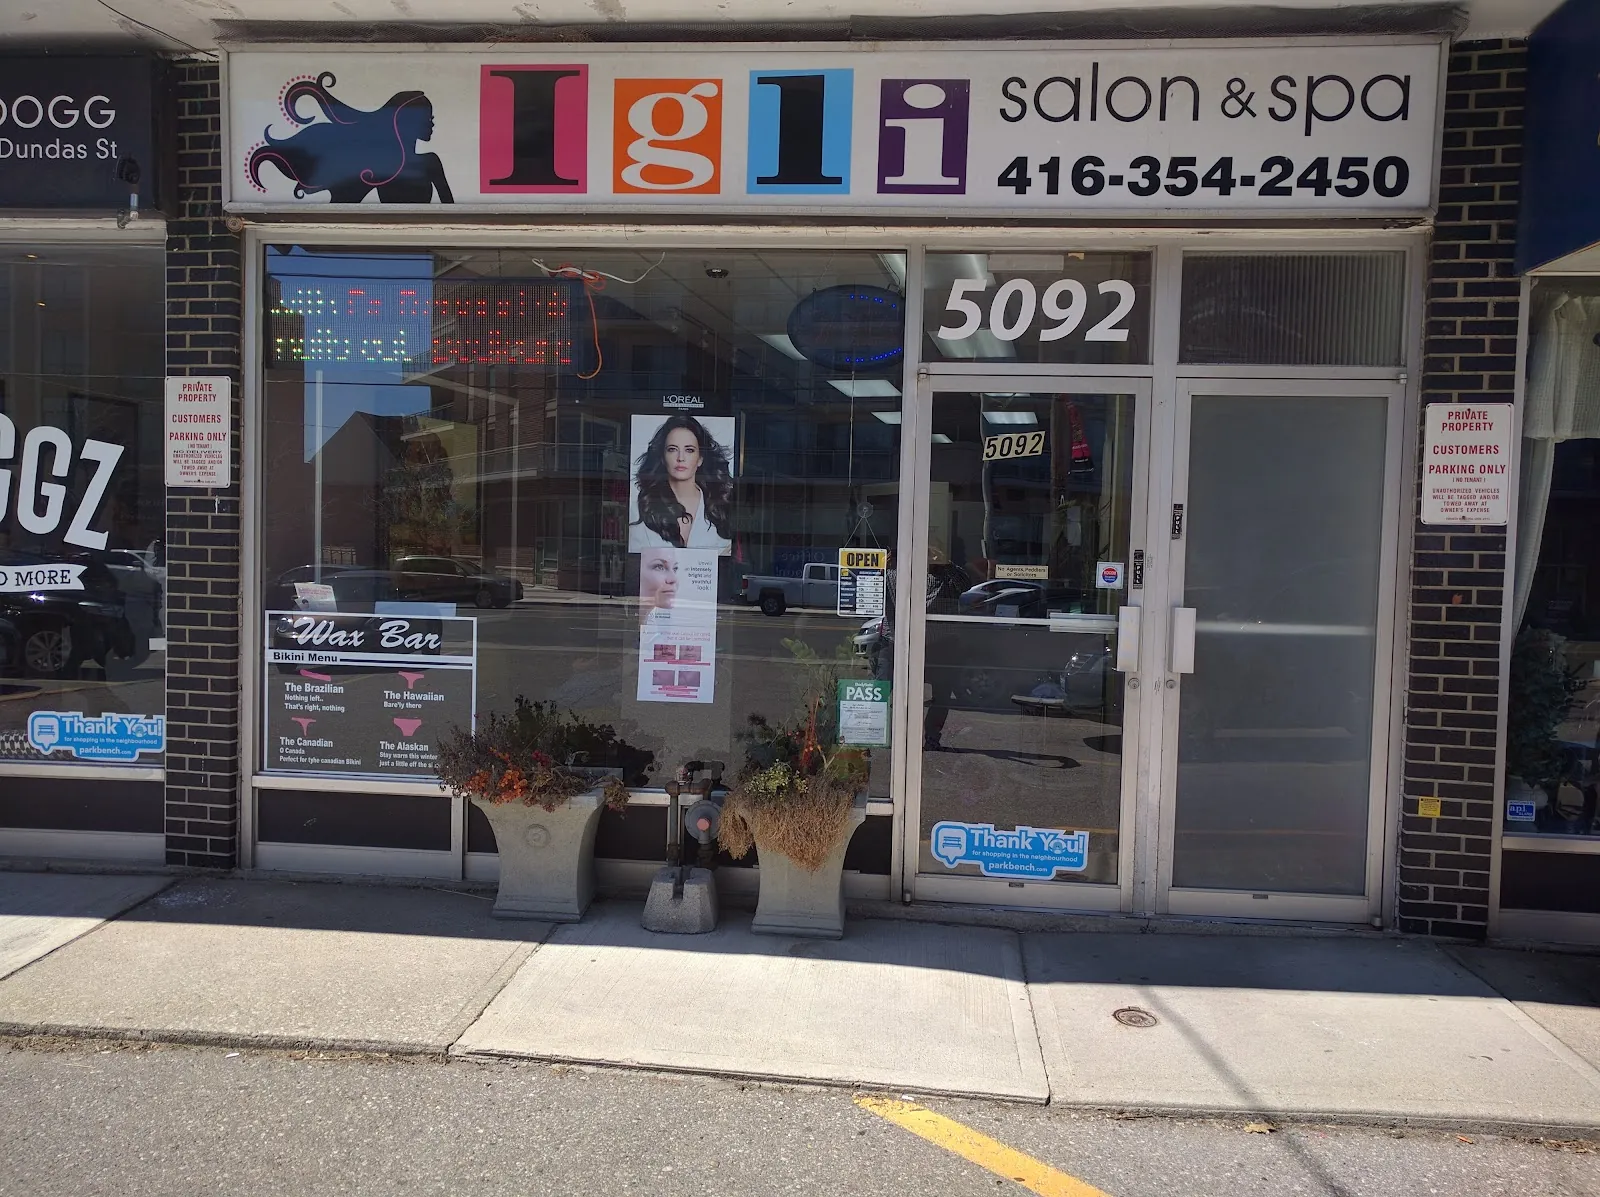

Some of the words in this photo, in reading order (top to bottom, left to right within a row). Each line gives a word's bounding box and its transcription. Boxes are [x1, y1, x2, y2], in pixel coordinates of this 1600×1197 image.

[999, 62, 1199, 122] salon
[1220, 77, 1257, 119] &
[1268, 74, 1411, 136] spa
[0, 95, 116, 129] OGG
[96, 138, 118, 159] St
[997, 156, 1410, 197] 416-354-2450
[937, 278, 1136, 342] 5092
[182, 383, 212, 392] PRIVATE
[178, 394, 217, 402] PROPERTY
[663, 395, 704, 403] L'ORÉAL
[172, 414, 221, 423] CUSTOMERS
[1448, 411, 1488, 420] PRIVATE
[1442, 422, 1494, 431] PROPERTY
[169, 432, 204, 441] PARKING
[207, 432, 227, 441] ONLY
[985, 433, 1042, 458] 5092
[1433, 445, 1499, 454] CUSTOMERS
[1429, 465, 1475, 474] PARKING
[1480, 465, 1506, 474] ONLY
[846, 552, 879, 567] OPEN
[14, 569, 71, 587] MORE
[293, 618, 365, 647] Wax
[379, 620, 441, 650] Bar
[273, 651, 304, 662] Bikini
[308, 653, 338, 662] Menu
[284, 682, 302, 692] The
[304, 682, 344, 694] Brazilian
[284, 694, 308, 702] Nothing
[383, 690, 401, 700] The
[403, 691, 444, 701] Hawaiian
[846, 687, 882, 701] PASS
[304, 703, 321, 712] right,
[322, 705, 345, 713] nothing
[62, 716, 118, 735] Thank
[121, 718, 162, 737] You!
[280, 737, 295, 746] The
[297, 737, 333, 748] Canadian
[379, 741, 395, 750] The
[397, 742, 429, 751] Alaskan
[79, 746, 132, 755] parkbench.com
[280, 755, 299, 763] Perfect
[970, 829, 1032, 850] Thank
[1039, 833, 1085, 854] You!
[982, 851, 1011, 859] shopping
[1031, 854, 1078, 863] neighbourhood
[988, 861, 1048, 872] parkbench.com
